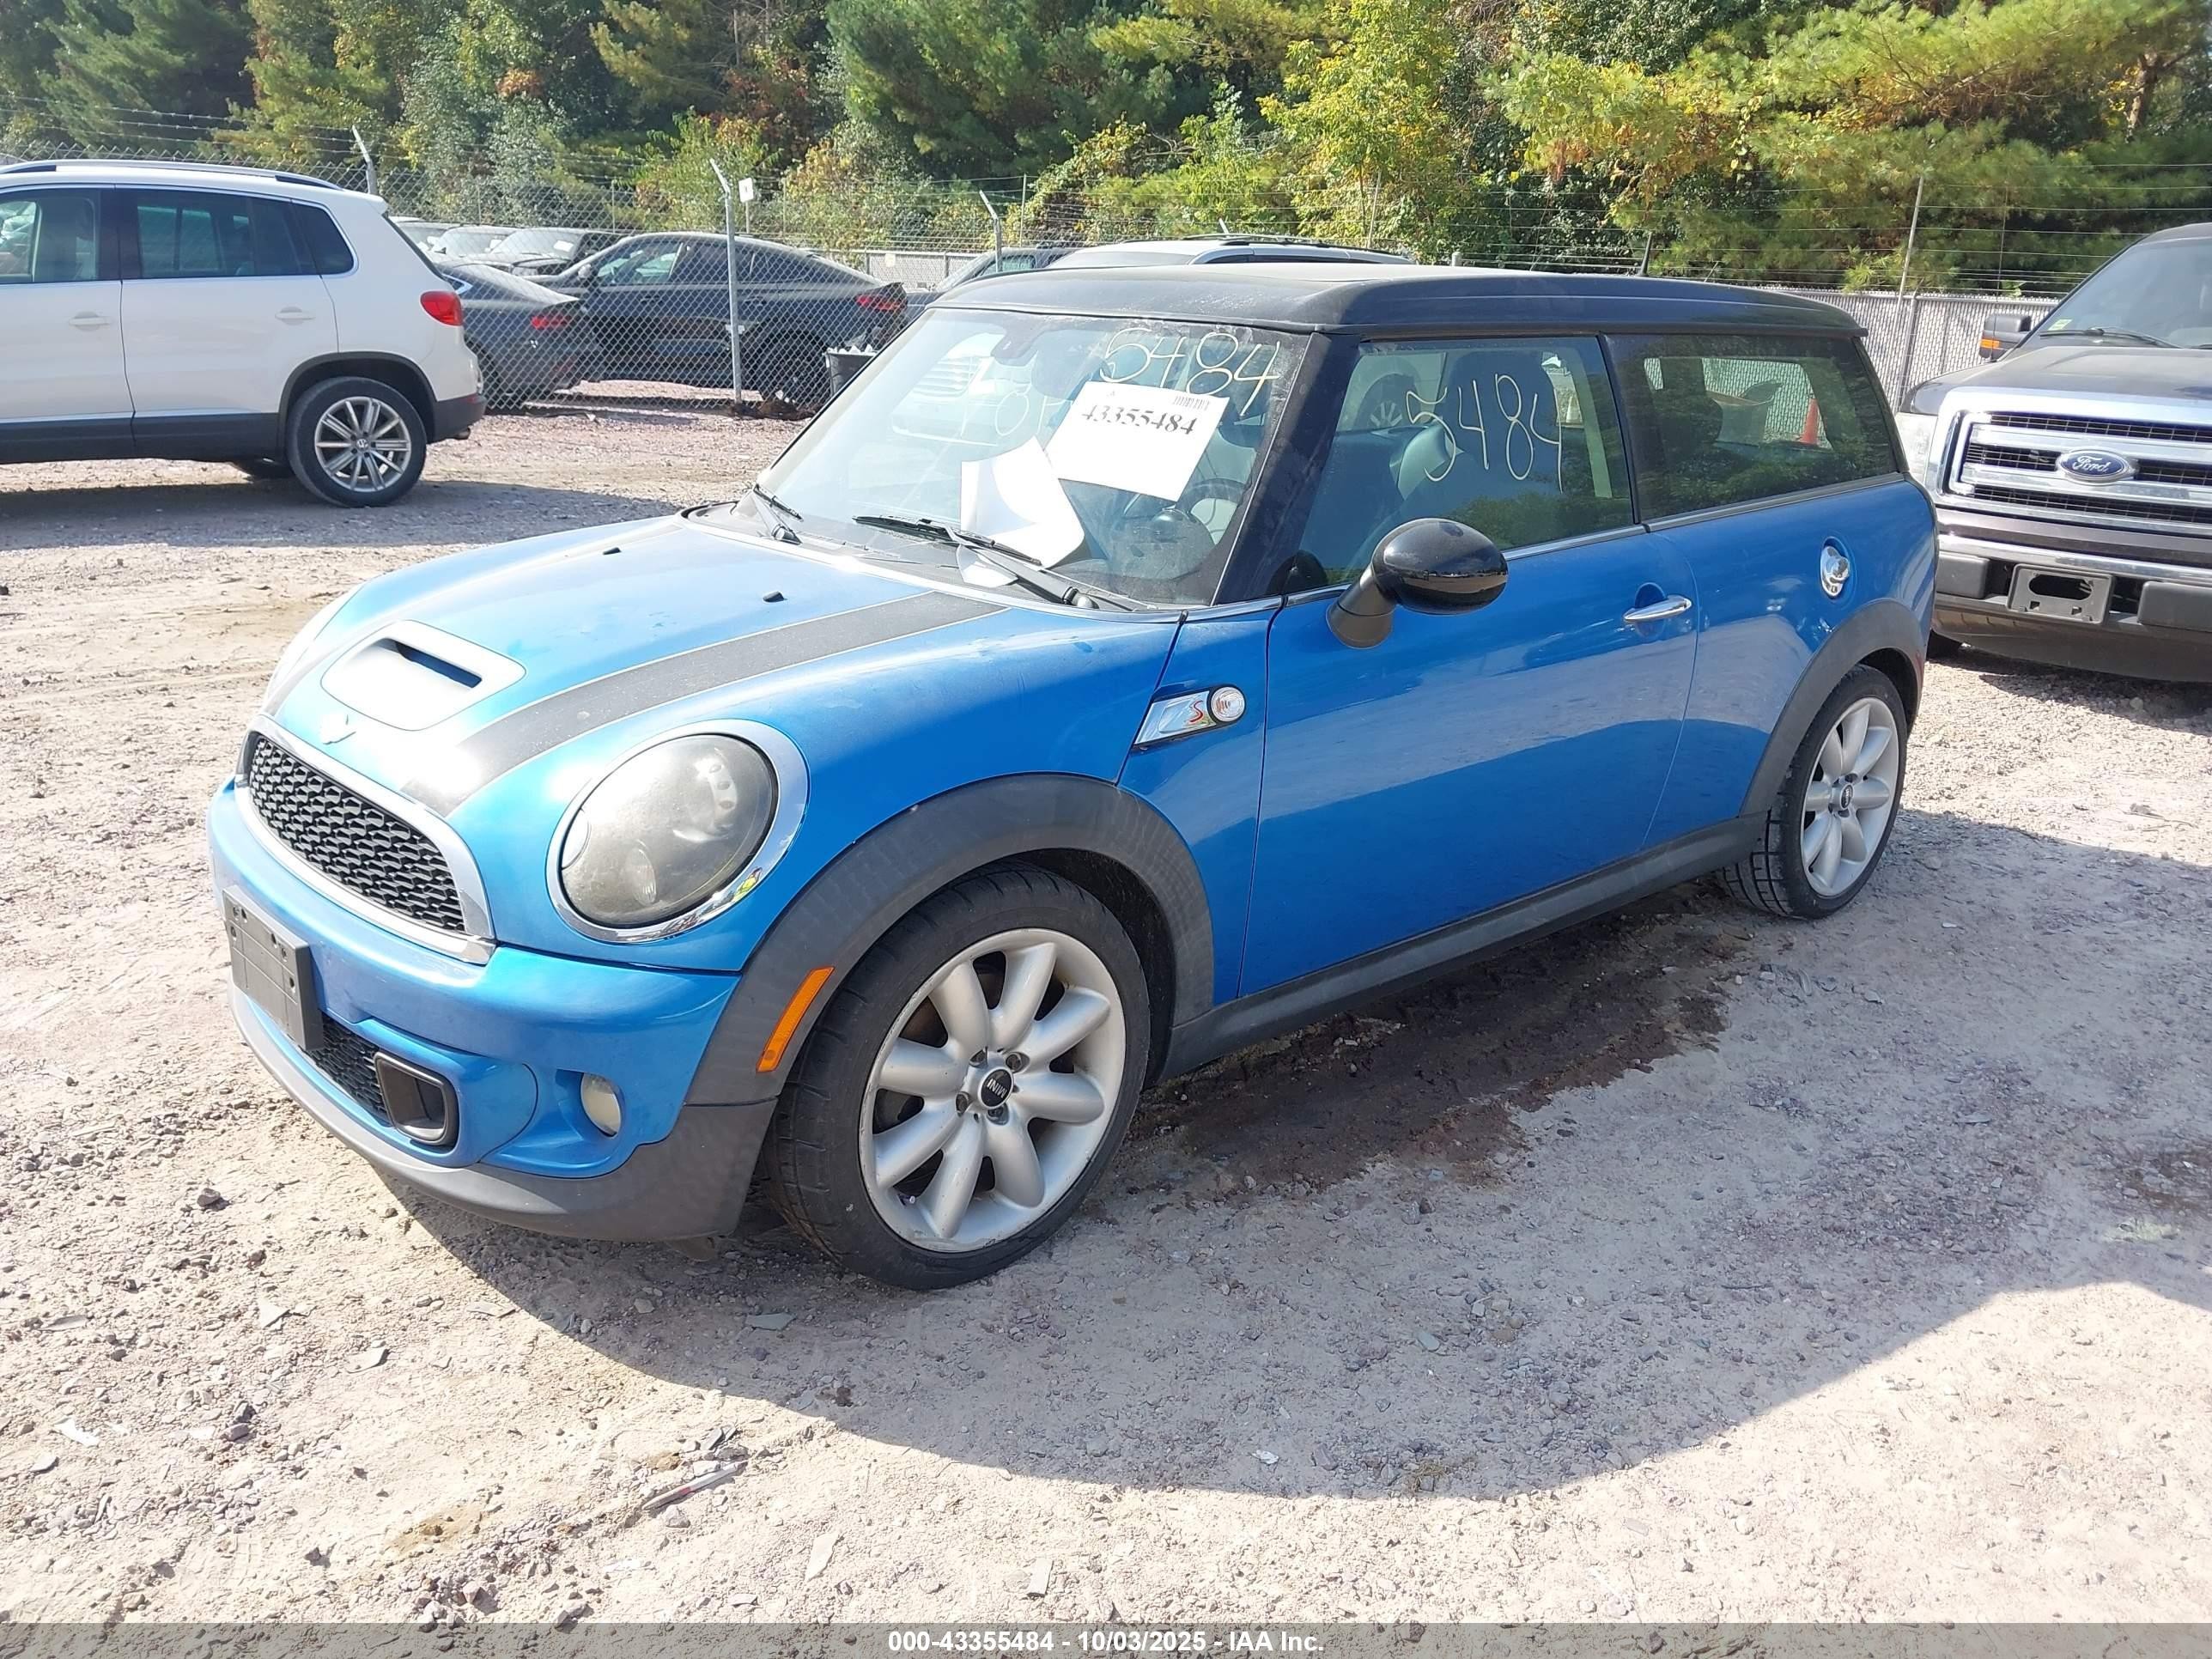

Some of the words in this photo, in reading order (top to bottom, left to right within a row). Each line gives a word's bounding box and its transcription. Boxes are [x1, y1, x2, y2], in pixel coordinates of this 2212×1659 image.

[1099, 327, 1281, 416] 5484
[1082, 404, 1198, 435] 43355484
[1406, 373, 1564, 495] 5484
[2072, 455, 2112, 472] Ford
[987, 1078, 1008, 1099] MINI
